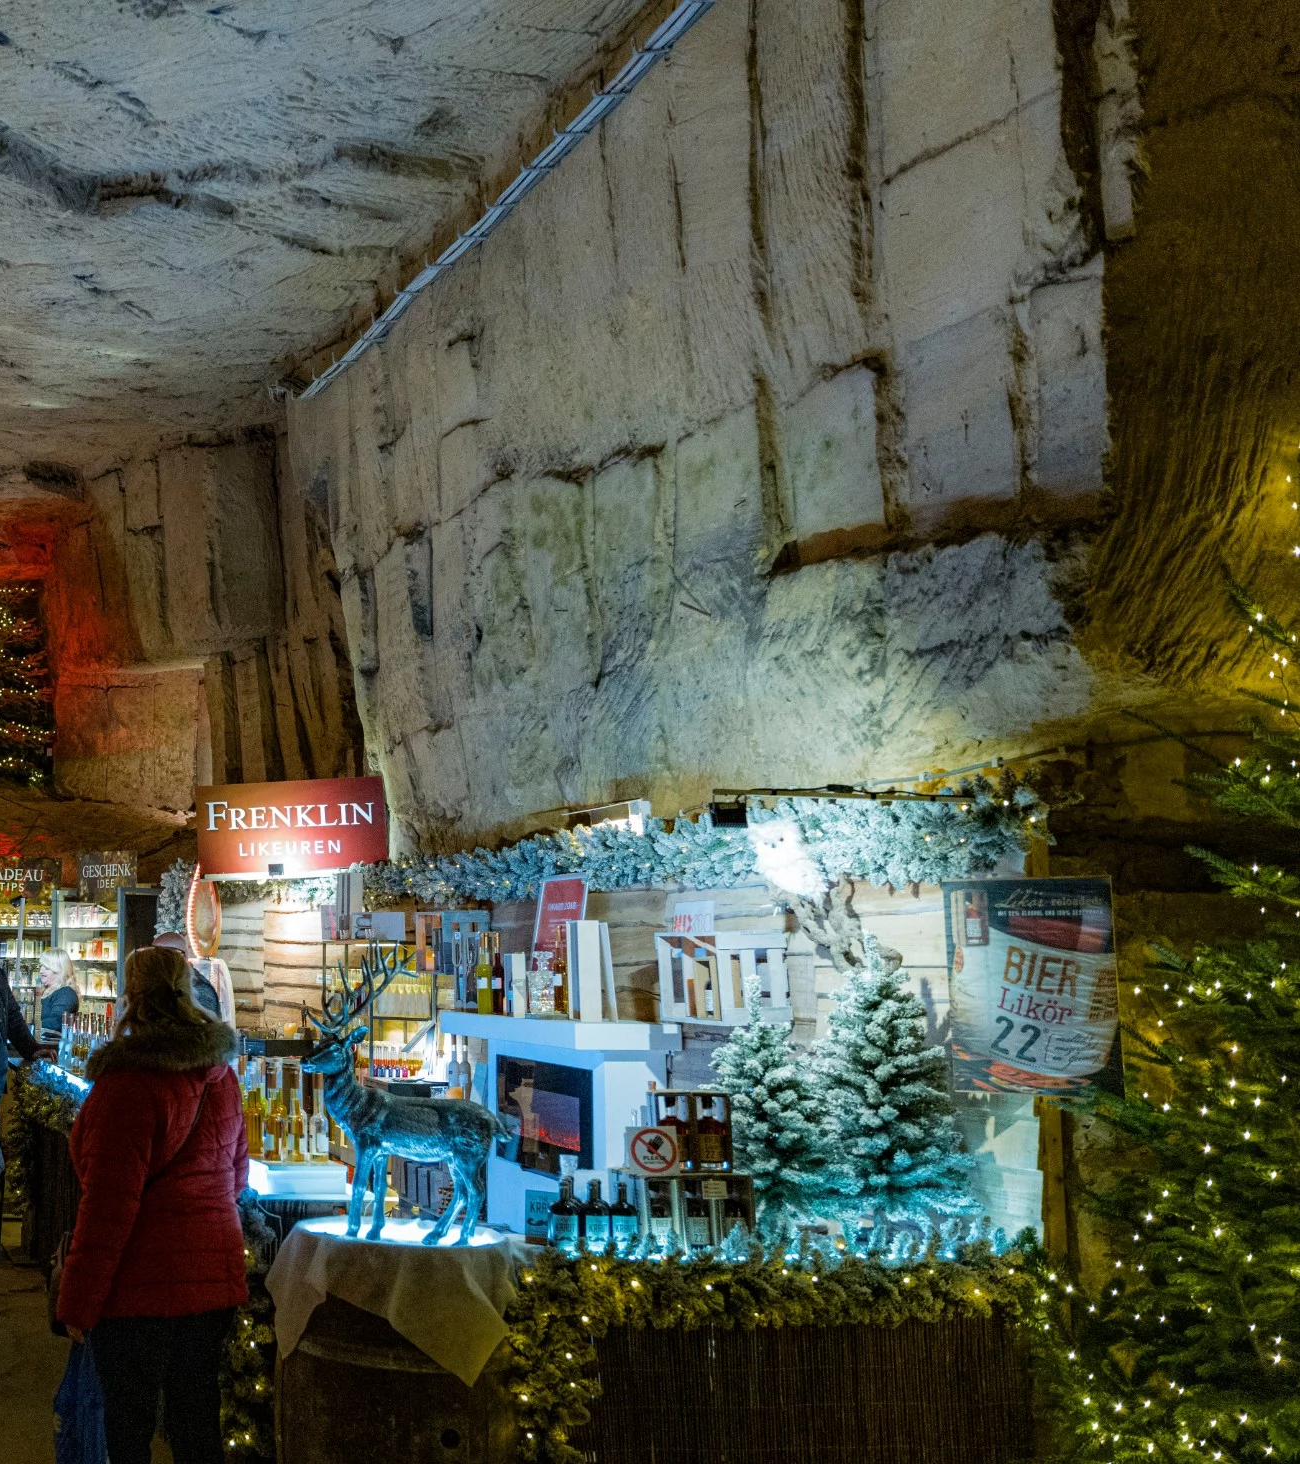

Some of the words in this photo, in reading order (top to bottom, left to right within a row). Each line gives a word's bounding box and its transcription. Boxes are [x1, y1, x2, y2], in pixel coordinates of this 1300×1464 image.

[205, 801, 374, 831] FRENKLIN
[239, 839, 341, 857] LIKEUREN
[82, 863, 131, 878] GESCHENK
[0, 882, 25, 892] TIPS
[97, 879, 115, 889] IDEE
[1003, 946, 1081, 997] BIER
[997, 986, 1072, 1025] Likör
